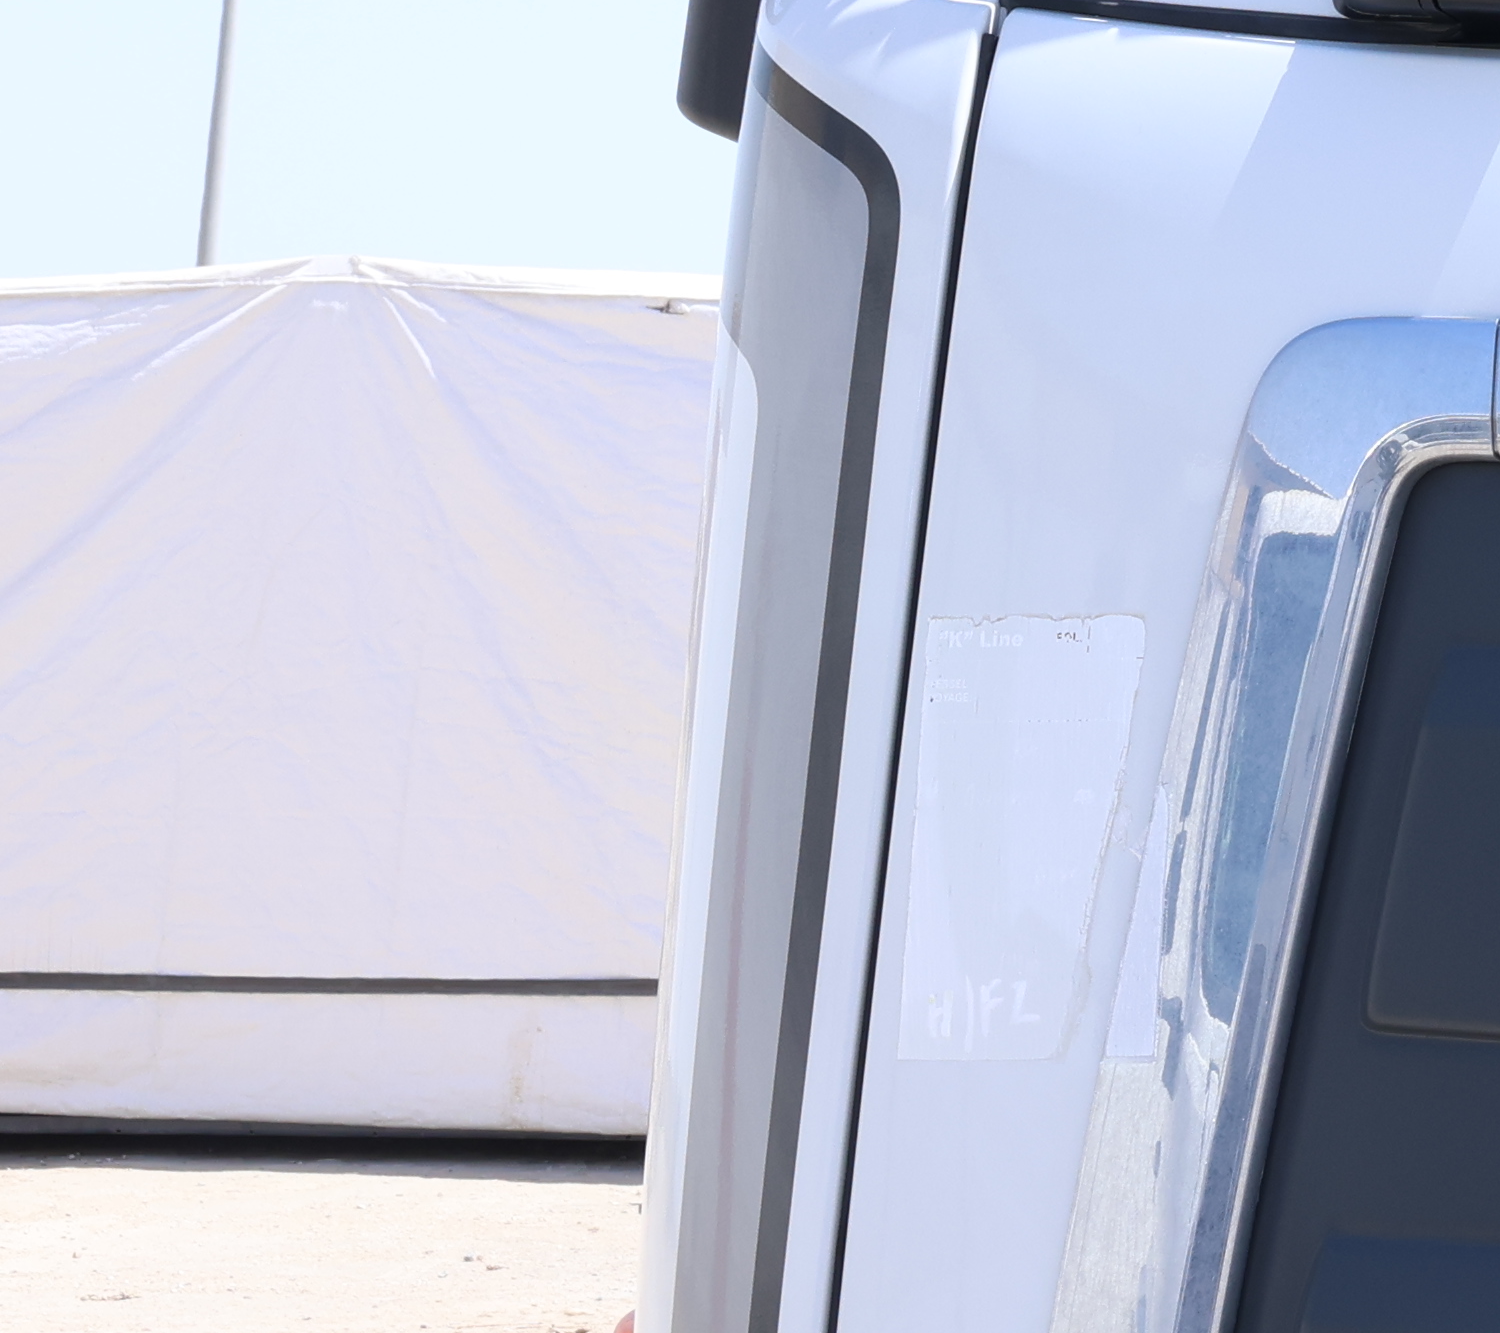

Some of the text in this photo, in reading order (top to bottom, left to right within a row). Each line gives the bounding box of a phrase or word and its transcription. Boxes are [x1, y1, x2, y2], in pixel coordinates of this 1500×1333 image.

[980, 631, 1024, 647] Line
[931, 679, 967, 689] ESSEL
[930, 693, 969, 702] OYAGE
